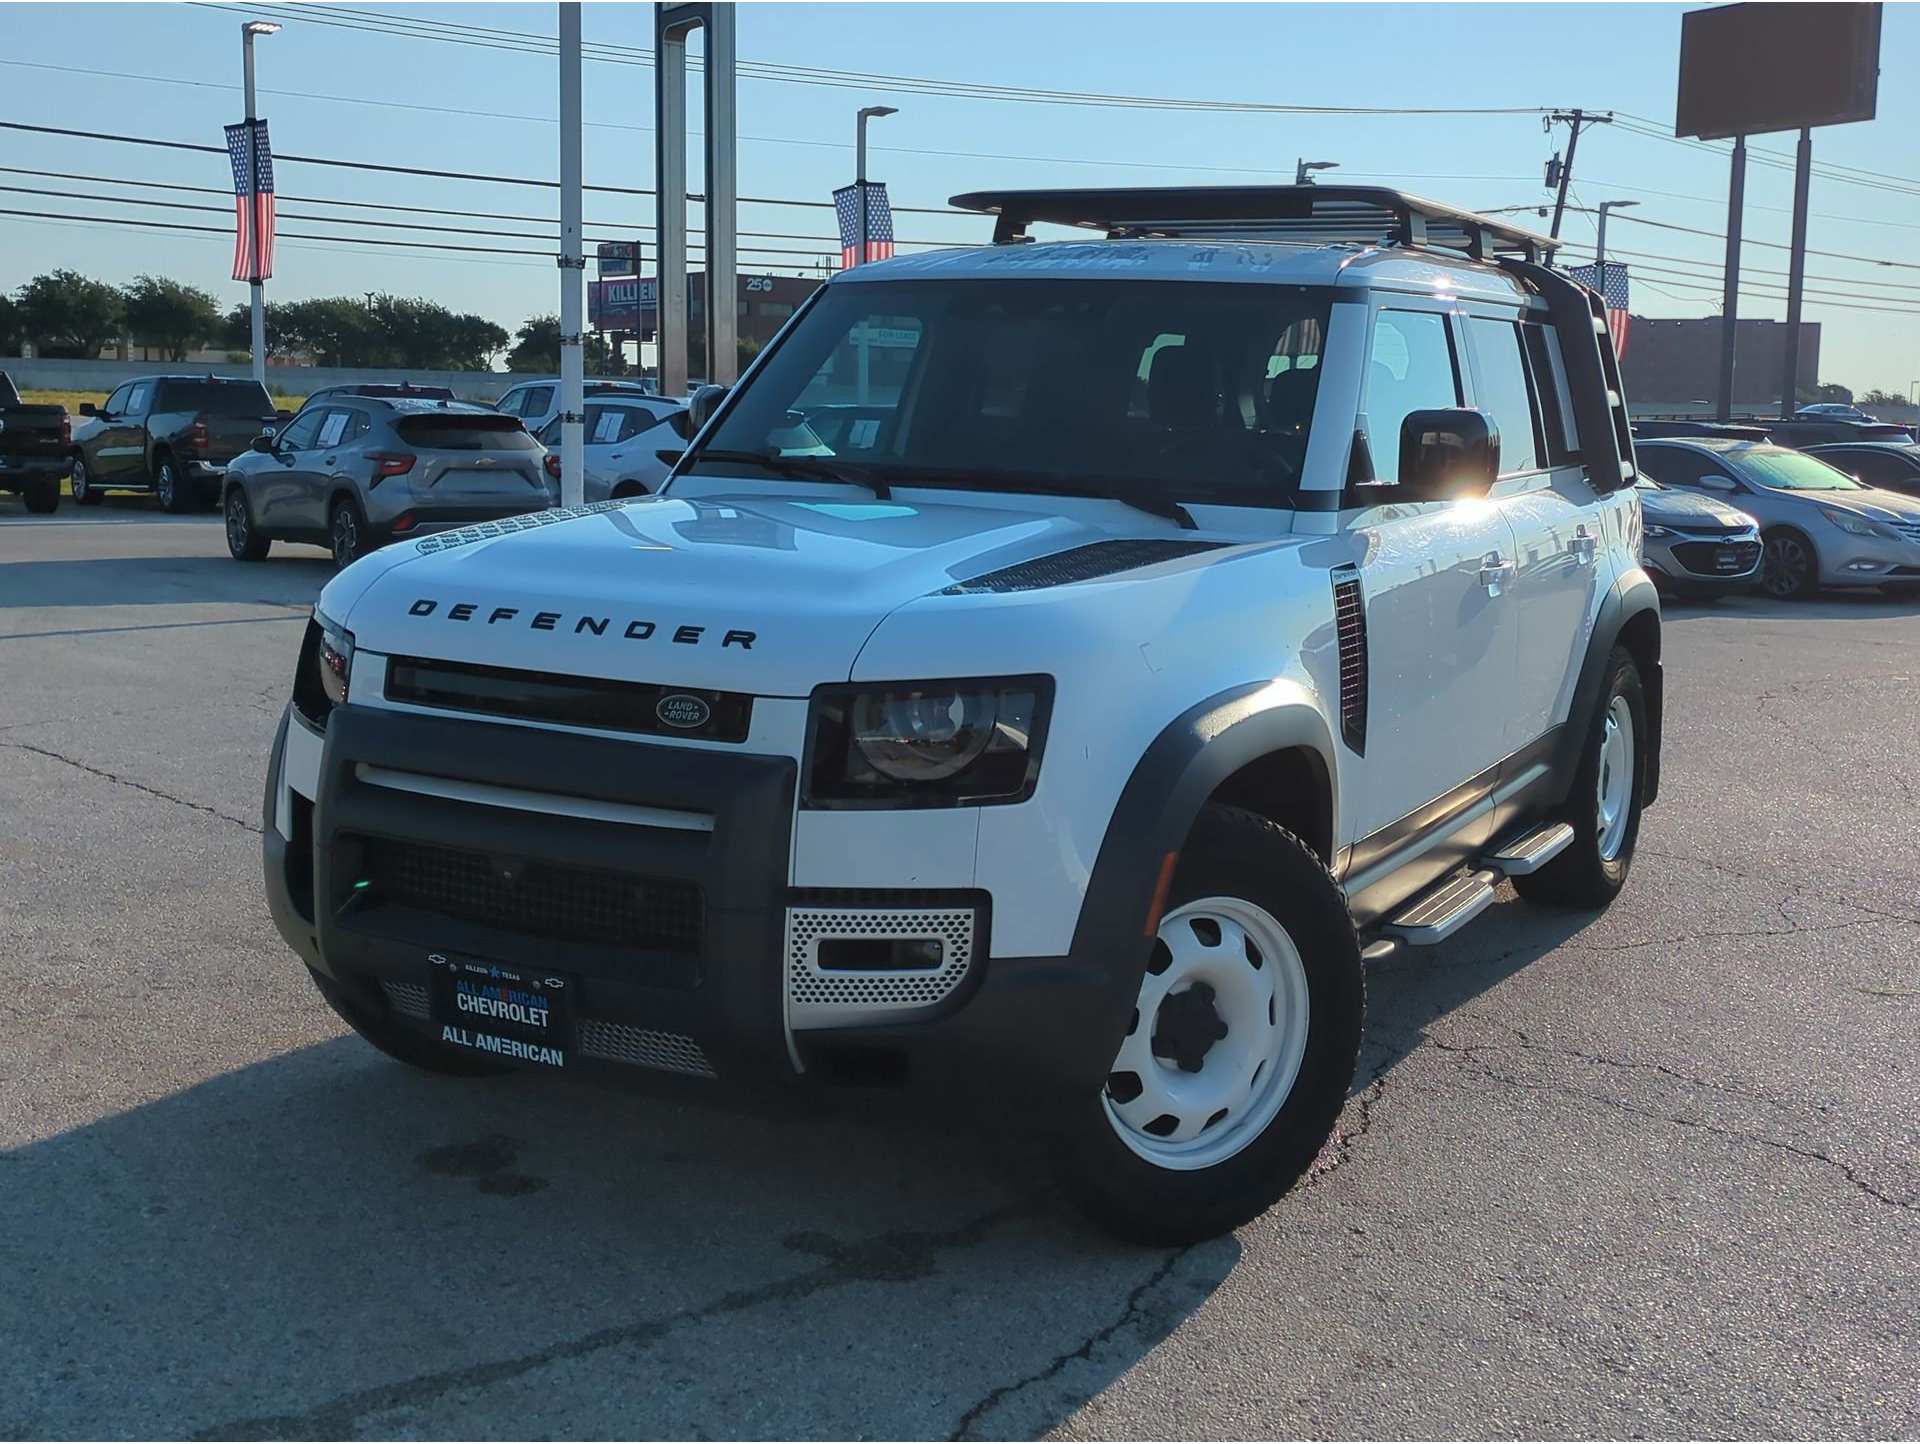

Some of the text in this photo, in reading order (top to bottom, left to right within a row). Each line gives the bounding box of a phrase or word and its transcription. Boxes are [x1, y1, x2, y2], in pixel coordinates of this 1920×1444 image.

[408, 599, 757, 650] DEFENDER
[667, 701, 694, 712] LAND
[669, 711, 700, 721] ROVER
[502, 971, 520, 981] TEXAS
[457, 980, 547, 1007] ALL AMERICAN
[457, 993, 548, 1027] CHEVROLET
[442, 1026, 564, 1066] ALL AMERICAN
